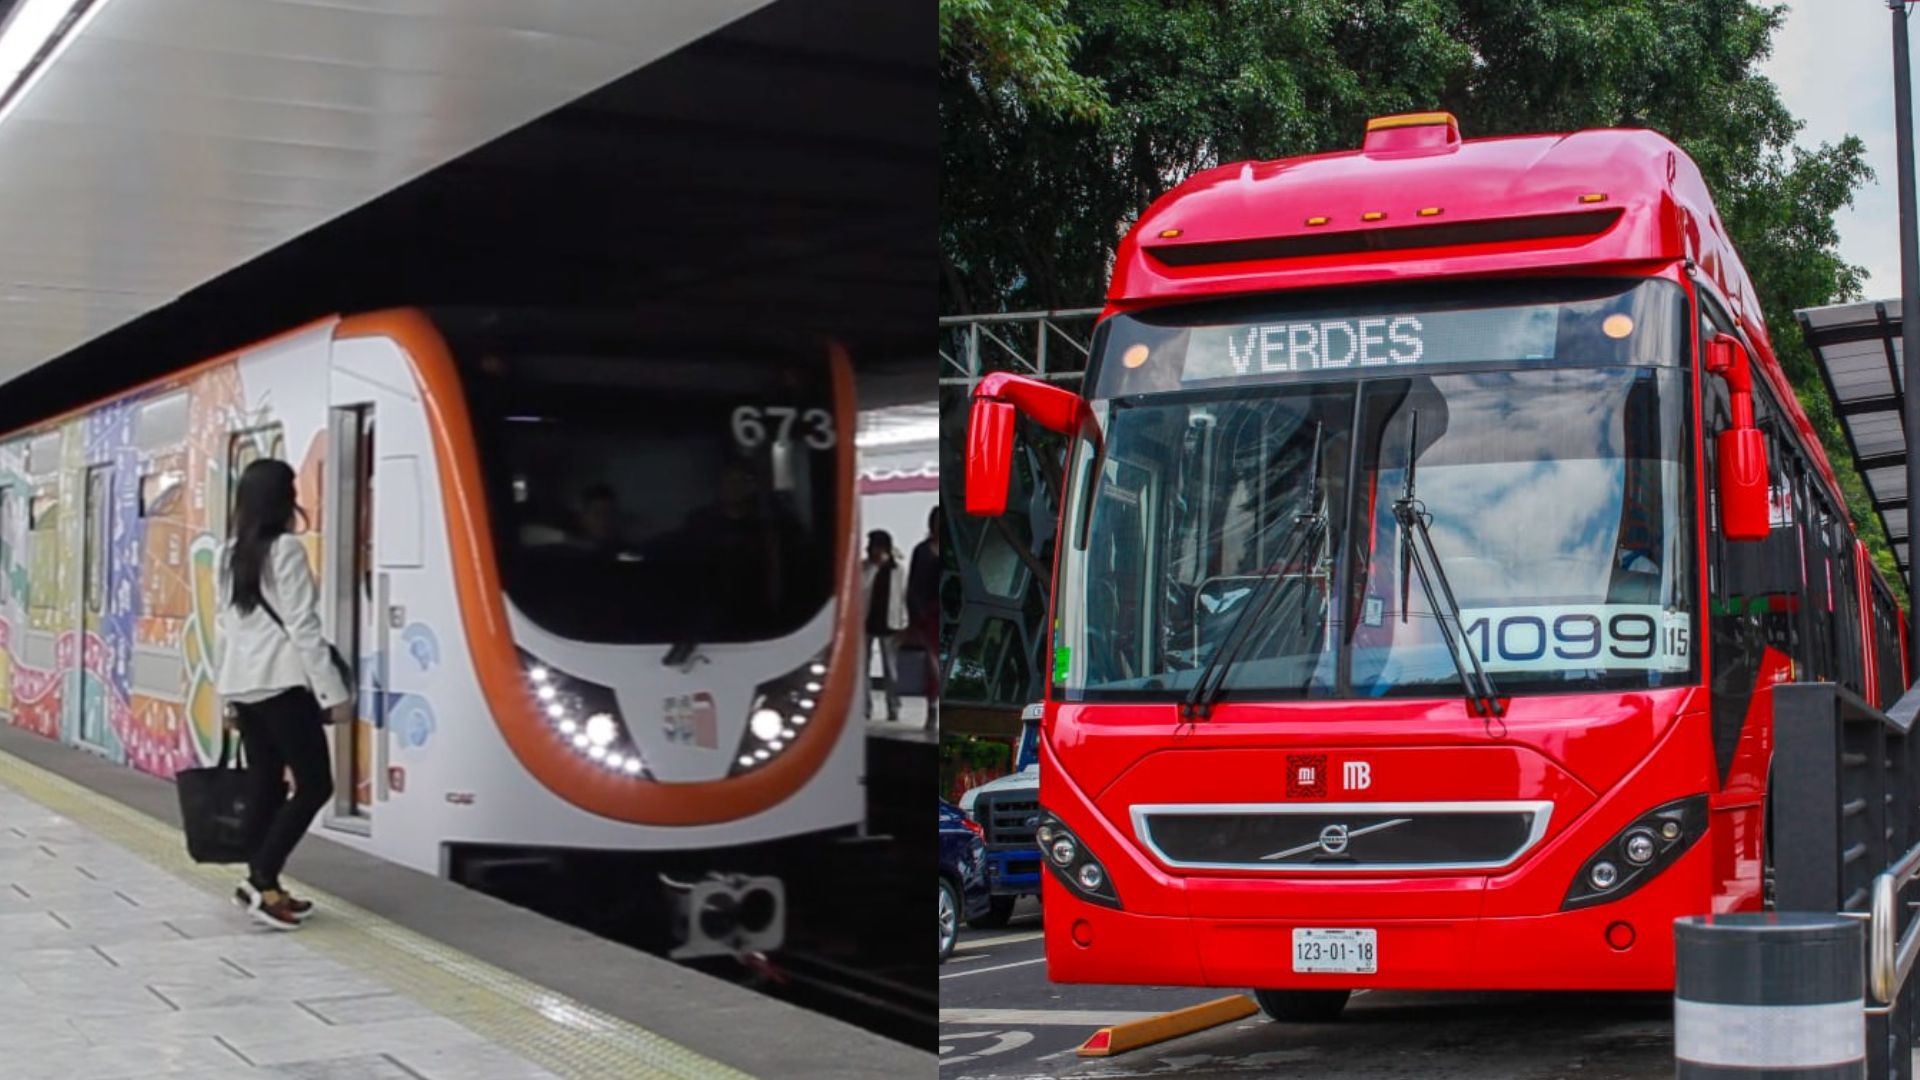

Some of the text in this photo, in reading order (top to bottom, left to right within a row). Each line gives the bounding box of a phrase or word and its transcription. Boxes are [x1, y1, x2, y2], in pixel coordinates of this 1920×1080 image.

[1228, 316, 1423, 374] VERDES
[731, 405, 837, 449] 673
[1466, 613, 1657, 662] 1099
[1343, 761, 1371, 790] MB
